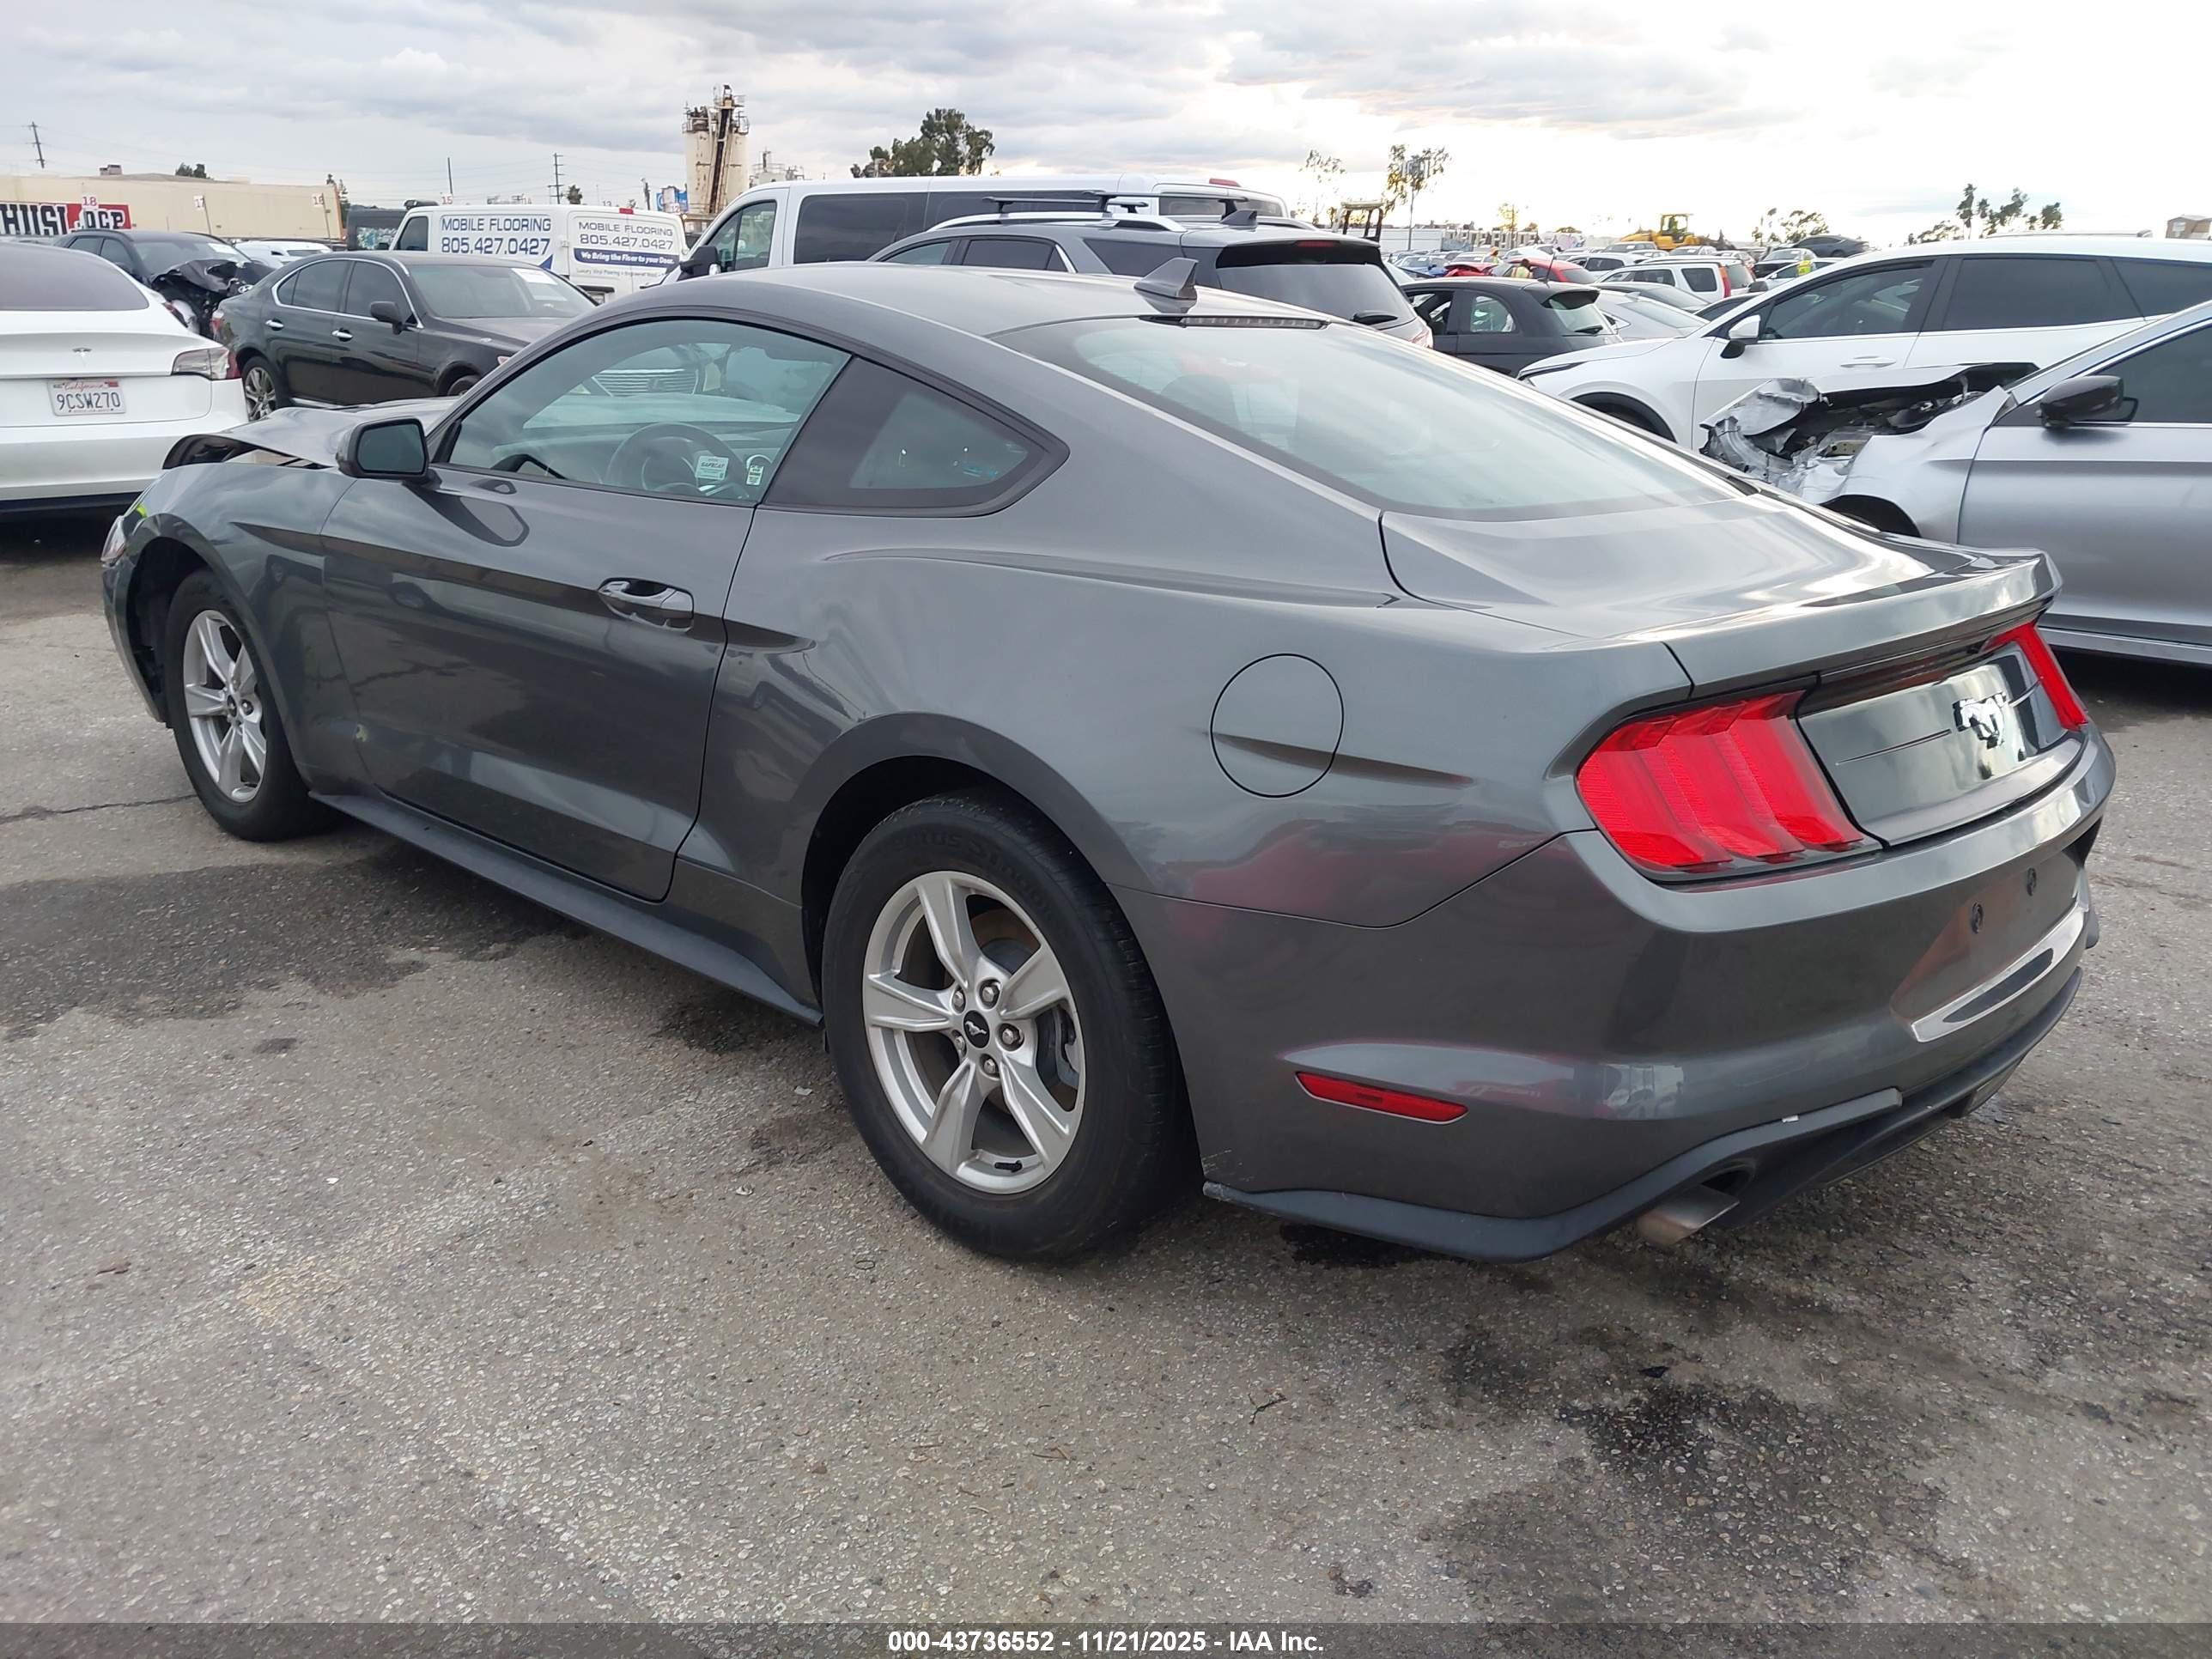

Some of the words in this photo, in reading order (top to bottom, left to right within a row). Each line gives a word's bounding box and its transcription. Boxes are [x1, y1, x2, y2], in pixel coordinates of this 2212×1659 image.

[82, 196, 98, 206] 18
[441, 218, 484, 232] MOBILE
[489, 218, 551, 232] FLOORING
[579, 222, 620, 233] MOBILE
[624, 224, 673, 236] FLOORING
[441, 236, 550, 255] 805.427.0427
[580, 234, 673, 250] 805.427.0427
[580, 251, 591, 259] We
[592, 252, 610, 262] Bring
[57, 392, 121, 410] 9CSW270
